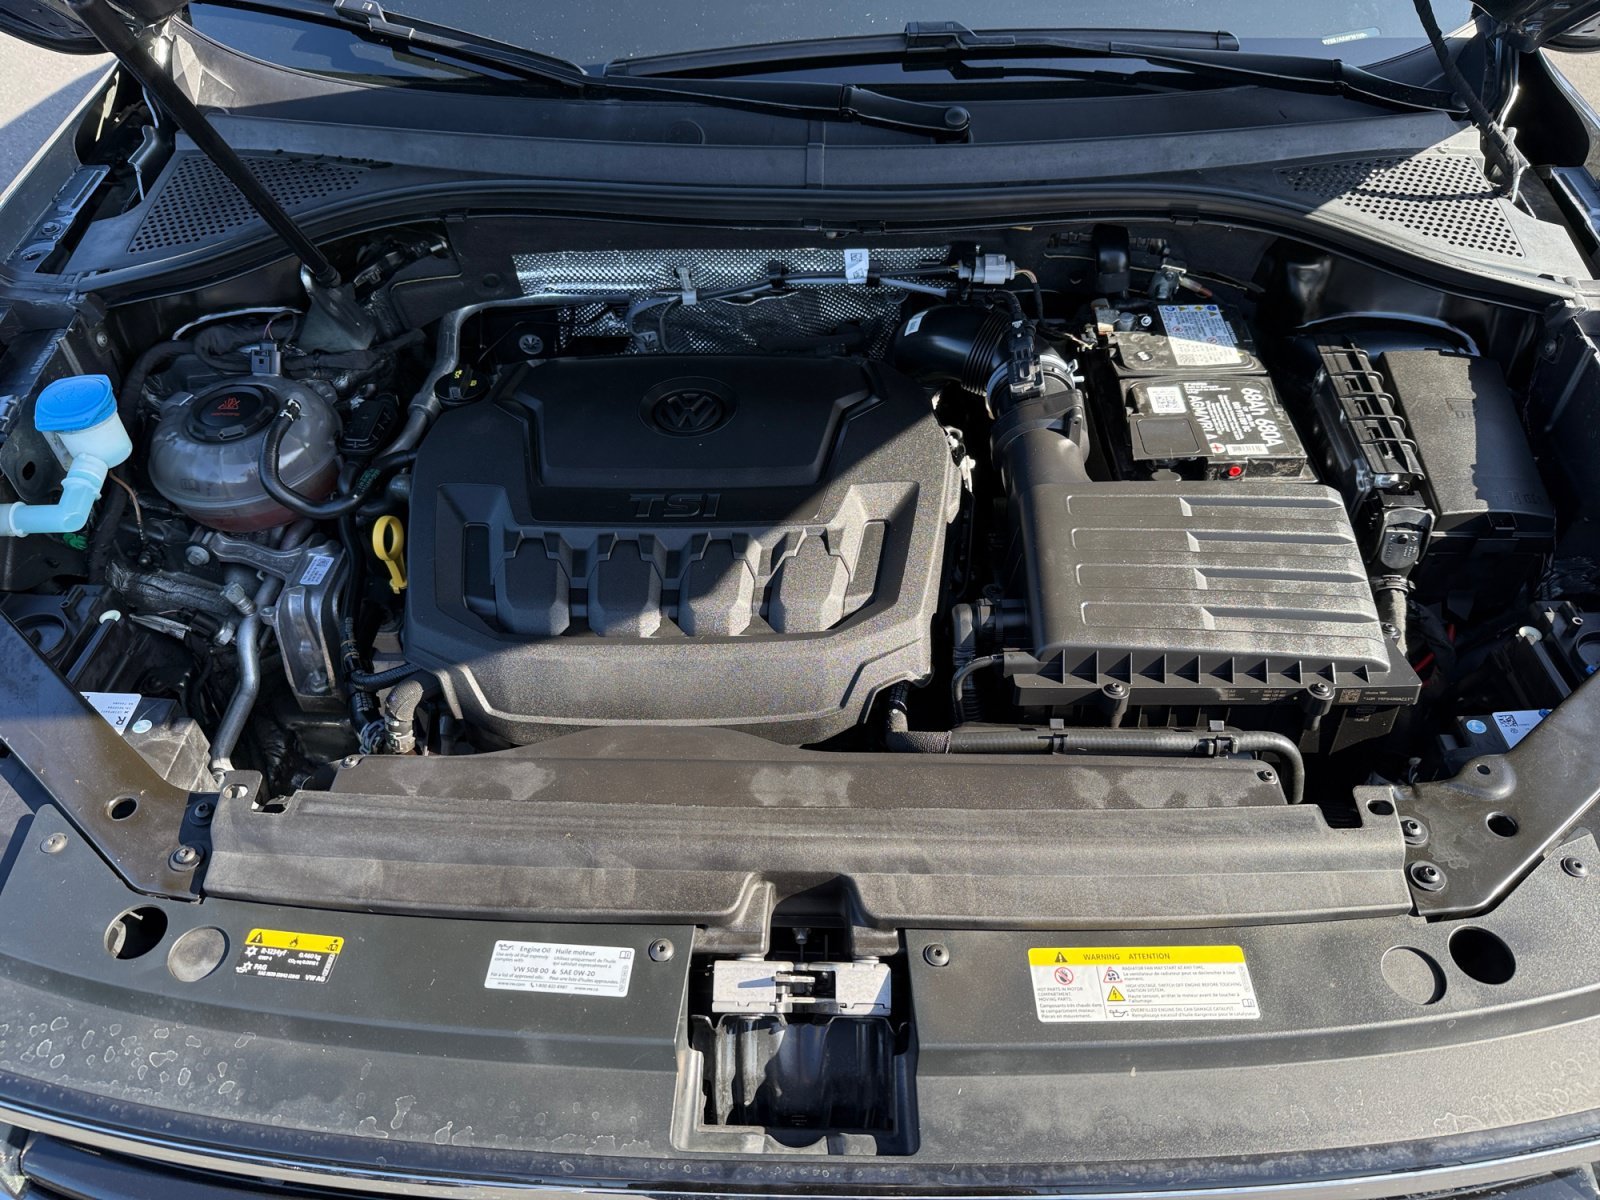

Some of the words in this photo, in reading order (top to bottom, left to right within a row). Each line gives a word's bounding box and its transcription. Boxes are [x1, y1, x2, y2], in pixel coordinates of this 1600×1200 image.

[1241, 388, 1269, 414] 68Ah
[1255, 418, 1284, 446] 680A
[630, 493, 720, 517] TSI
[116, 716, 126, 725] R
